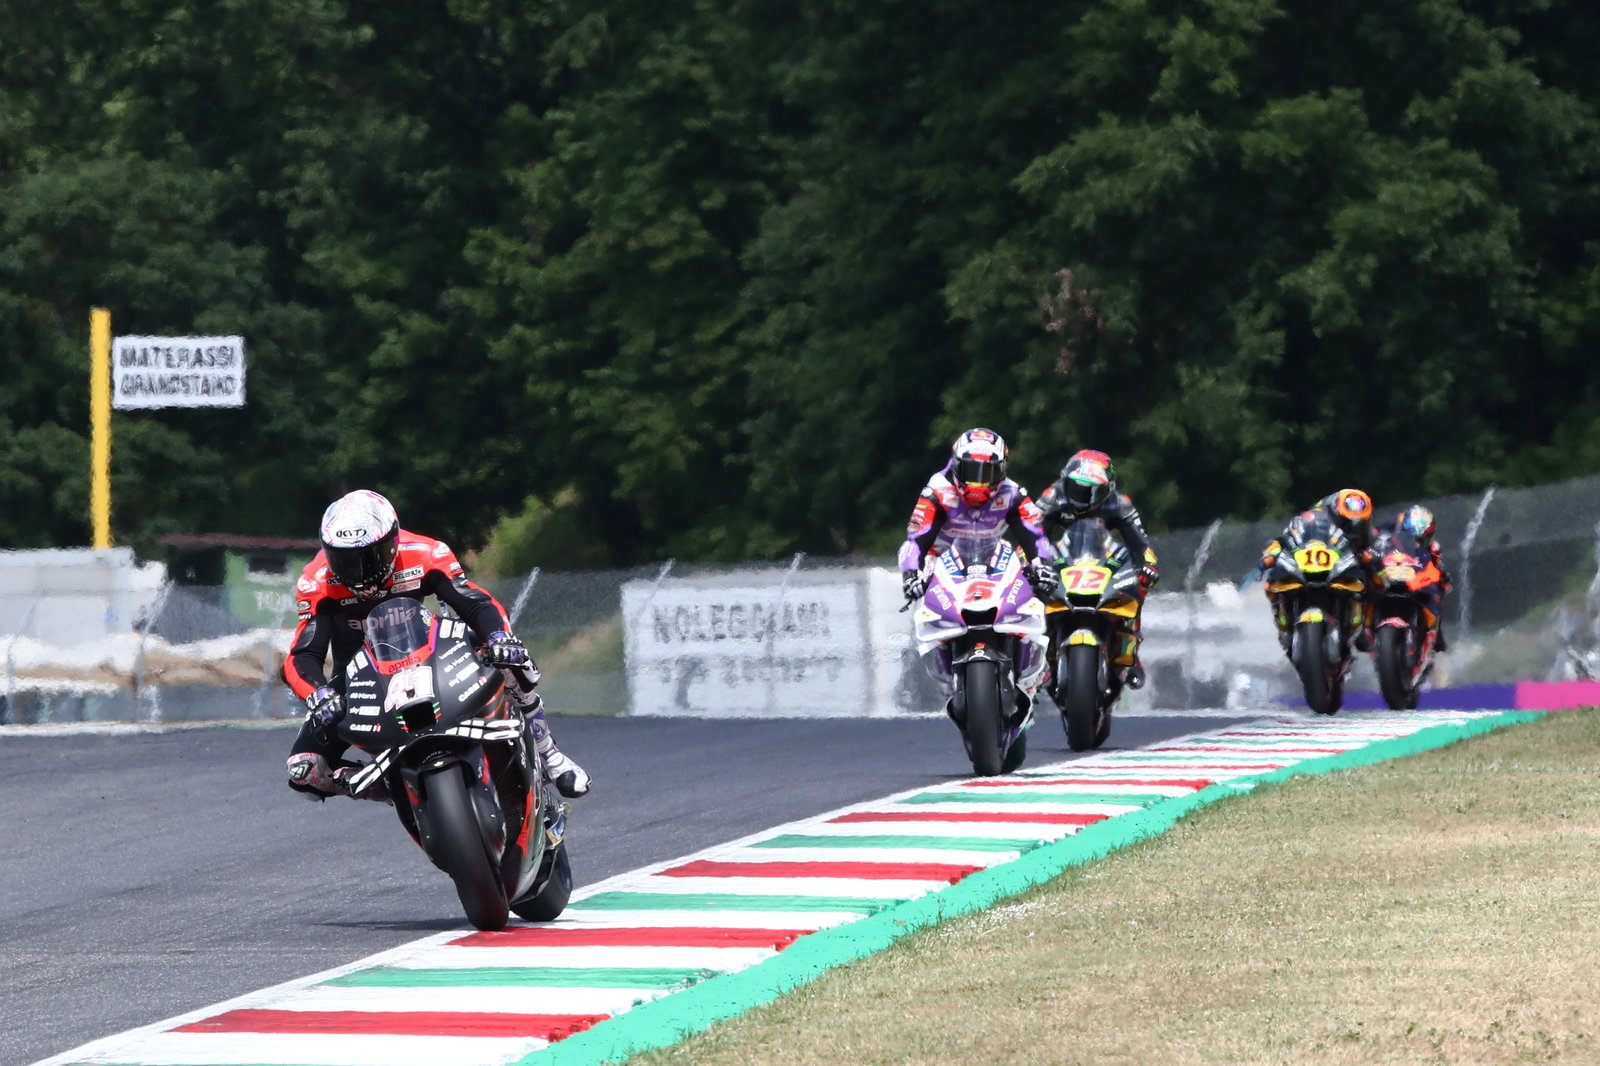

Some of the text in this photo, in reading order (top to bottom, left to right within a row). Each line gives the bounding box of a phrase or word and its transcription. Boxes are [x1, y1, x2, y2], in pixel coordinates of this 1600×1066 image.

[120, 345, 234, 368] MATERASSI
[1304, 550, 1331, 568] 10
[1065, 569, 1106, 589] 72
[347, 606, 417, 632] aprilia
[388, 655, 421, 673] aprilia
[349, 723, 373, 732] CASE
